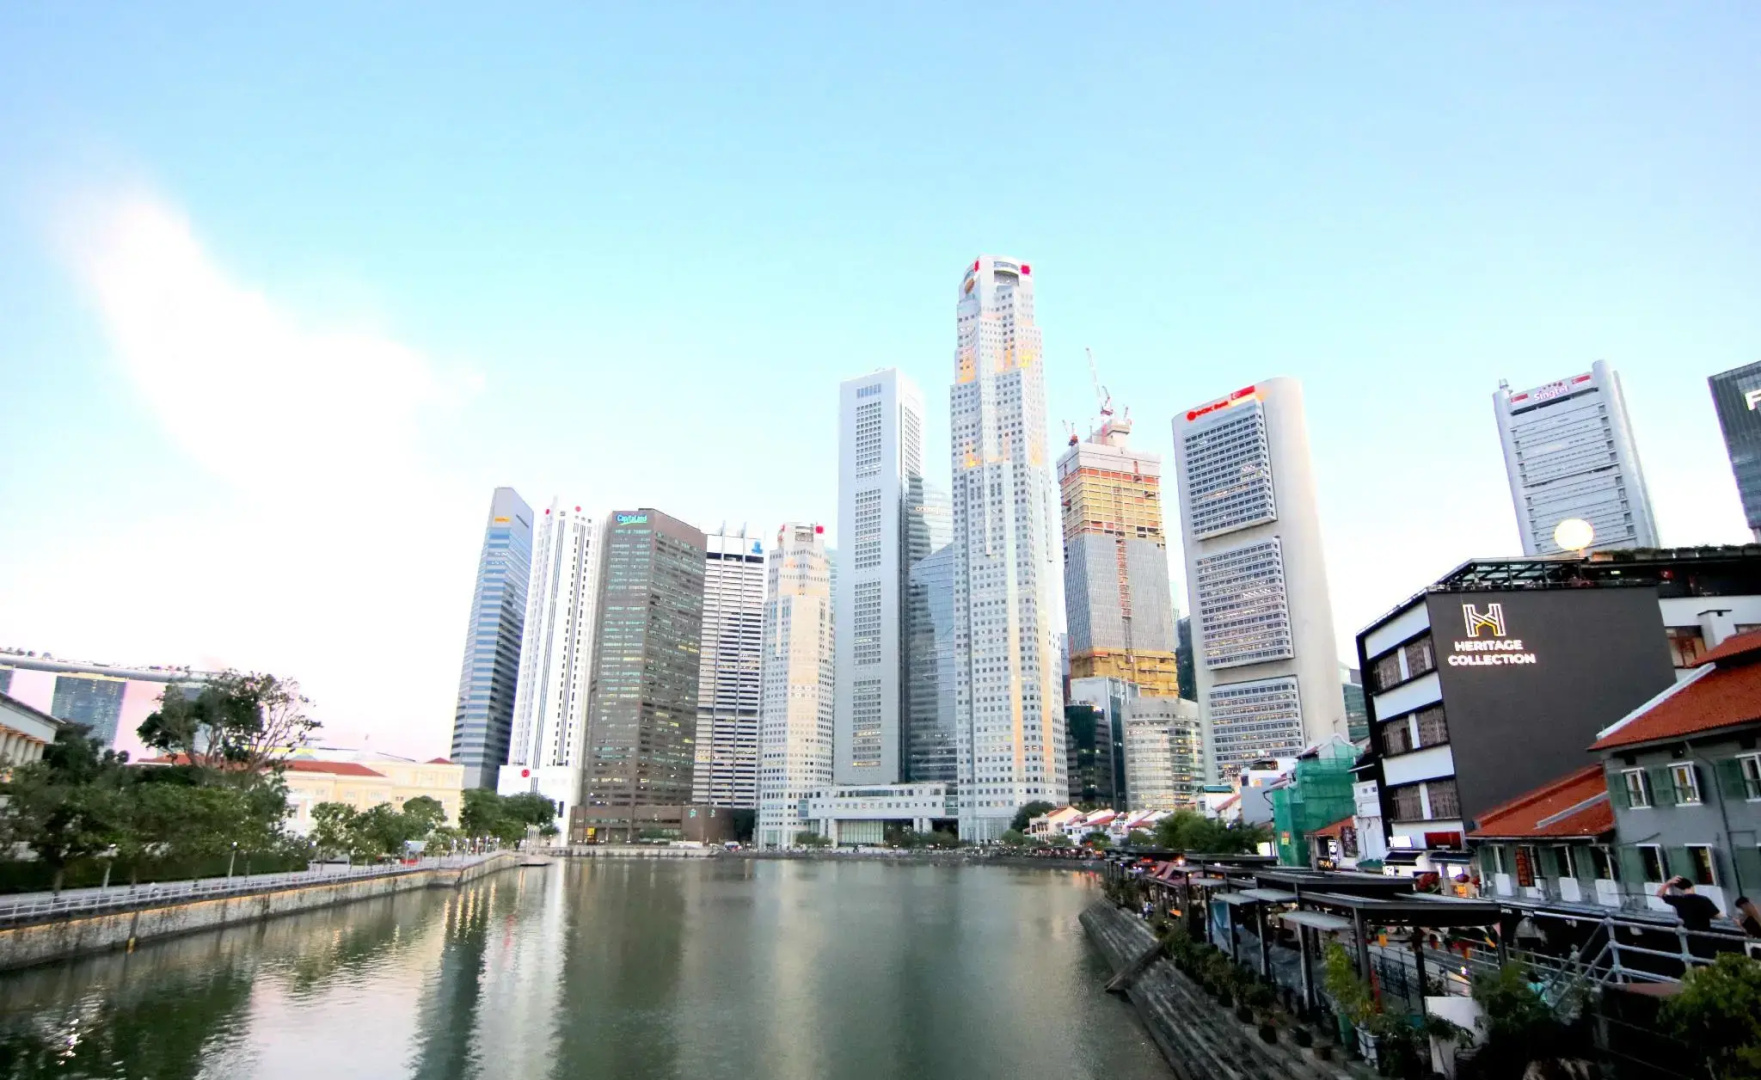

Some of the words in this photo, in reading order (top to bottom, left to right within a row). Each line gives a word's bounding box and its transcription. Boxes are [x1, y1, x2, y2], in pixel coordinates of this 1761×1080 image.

[1533, 385, 1569, 401] Singtel
[1454, 640, 1523, 651] HERITAGE
[1447, 653, 1536, 666] COLLECTION
